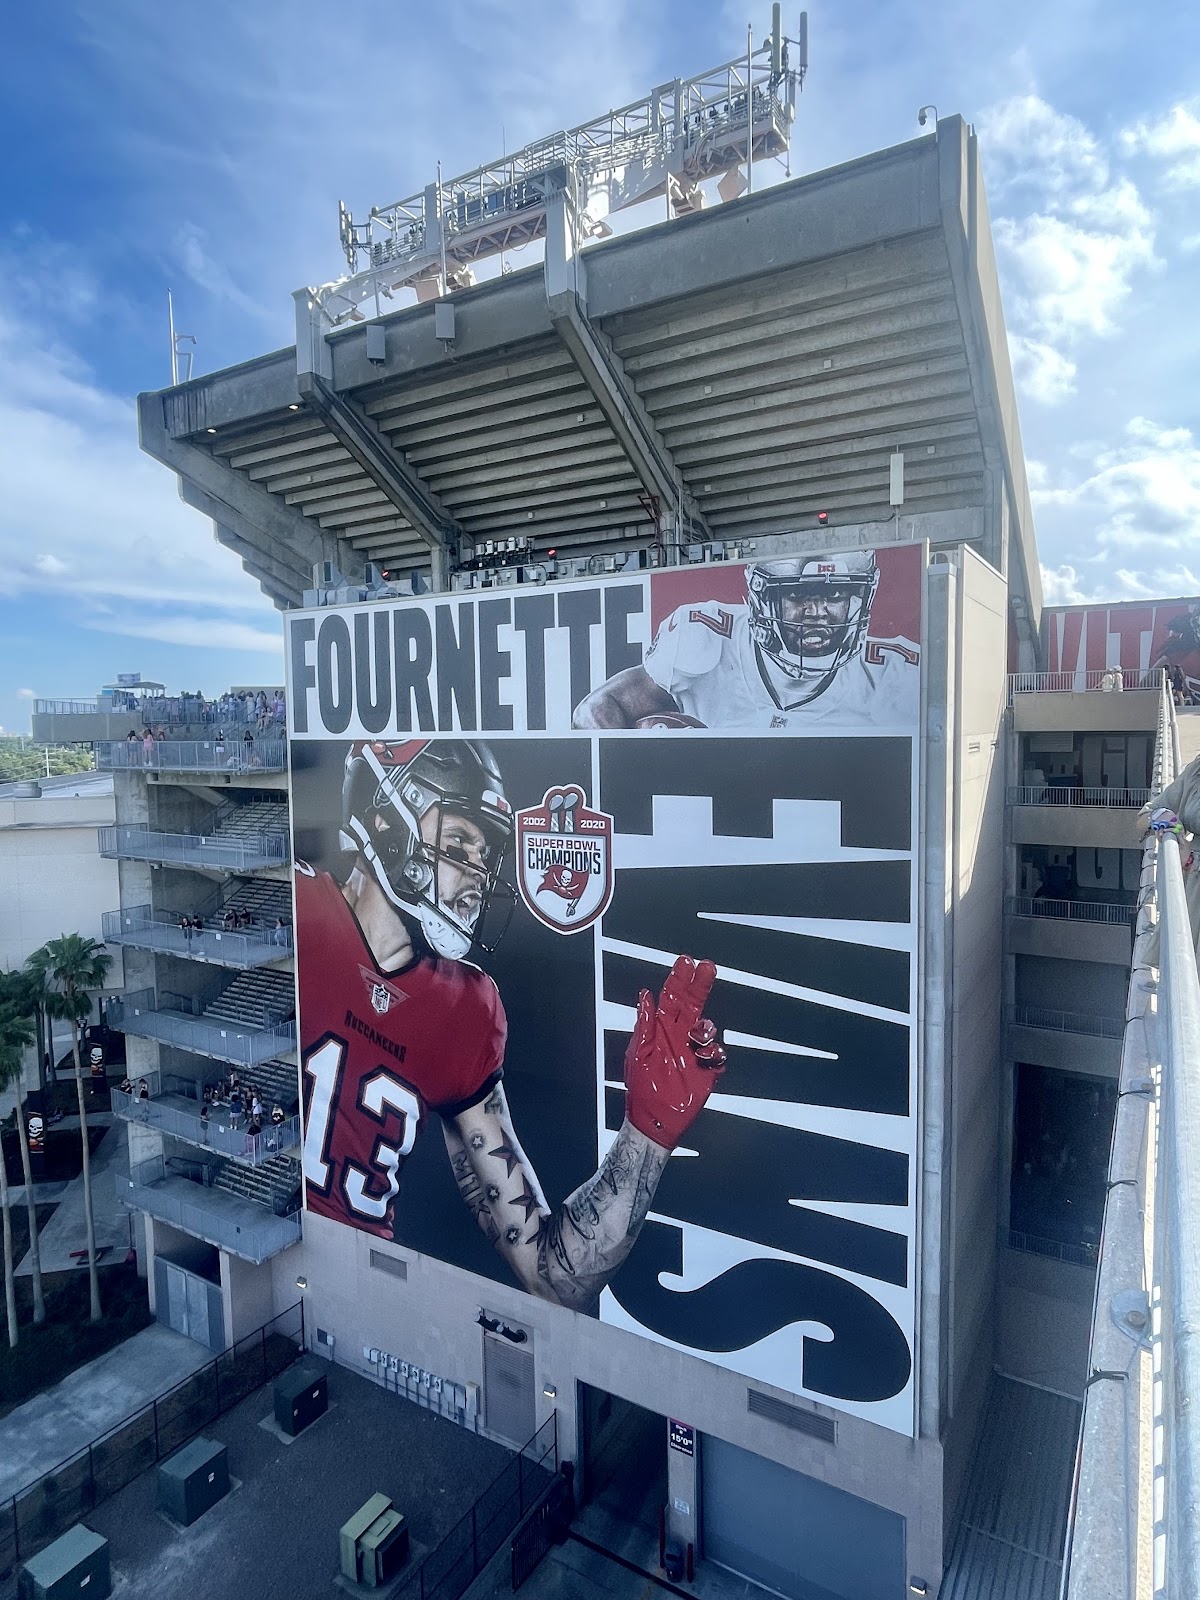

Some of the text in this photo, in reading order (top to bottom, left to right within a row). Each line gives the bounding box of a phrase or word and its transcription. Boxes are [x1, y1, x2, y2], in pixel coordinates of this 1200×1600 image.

[291, 584, 643, 734] FOURNETTE
[522, 816, 546, 826] 2002
[580, 819, 606, 830] 2020
[527, 837, 601, 852] SUPER BOWL
[528, 848, 601, 875] CHAMPIONS
[344, 1009, 407, 1064] BUCCANEERS
[600, 737, 913, 1402] EVANS
[302, 1034, 421, 1220] 13
